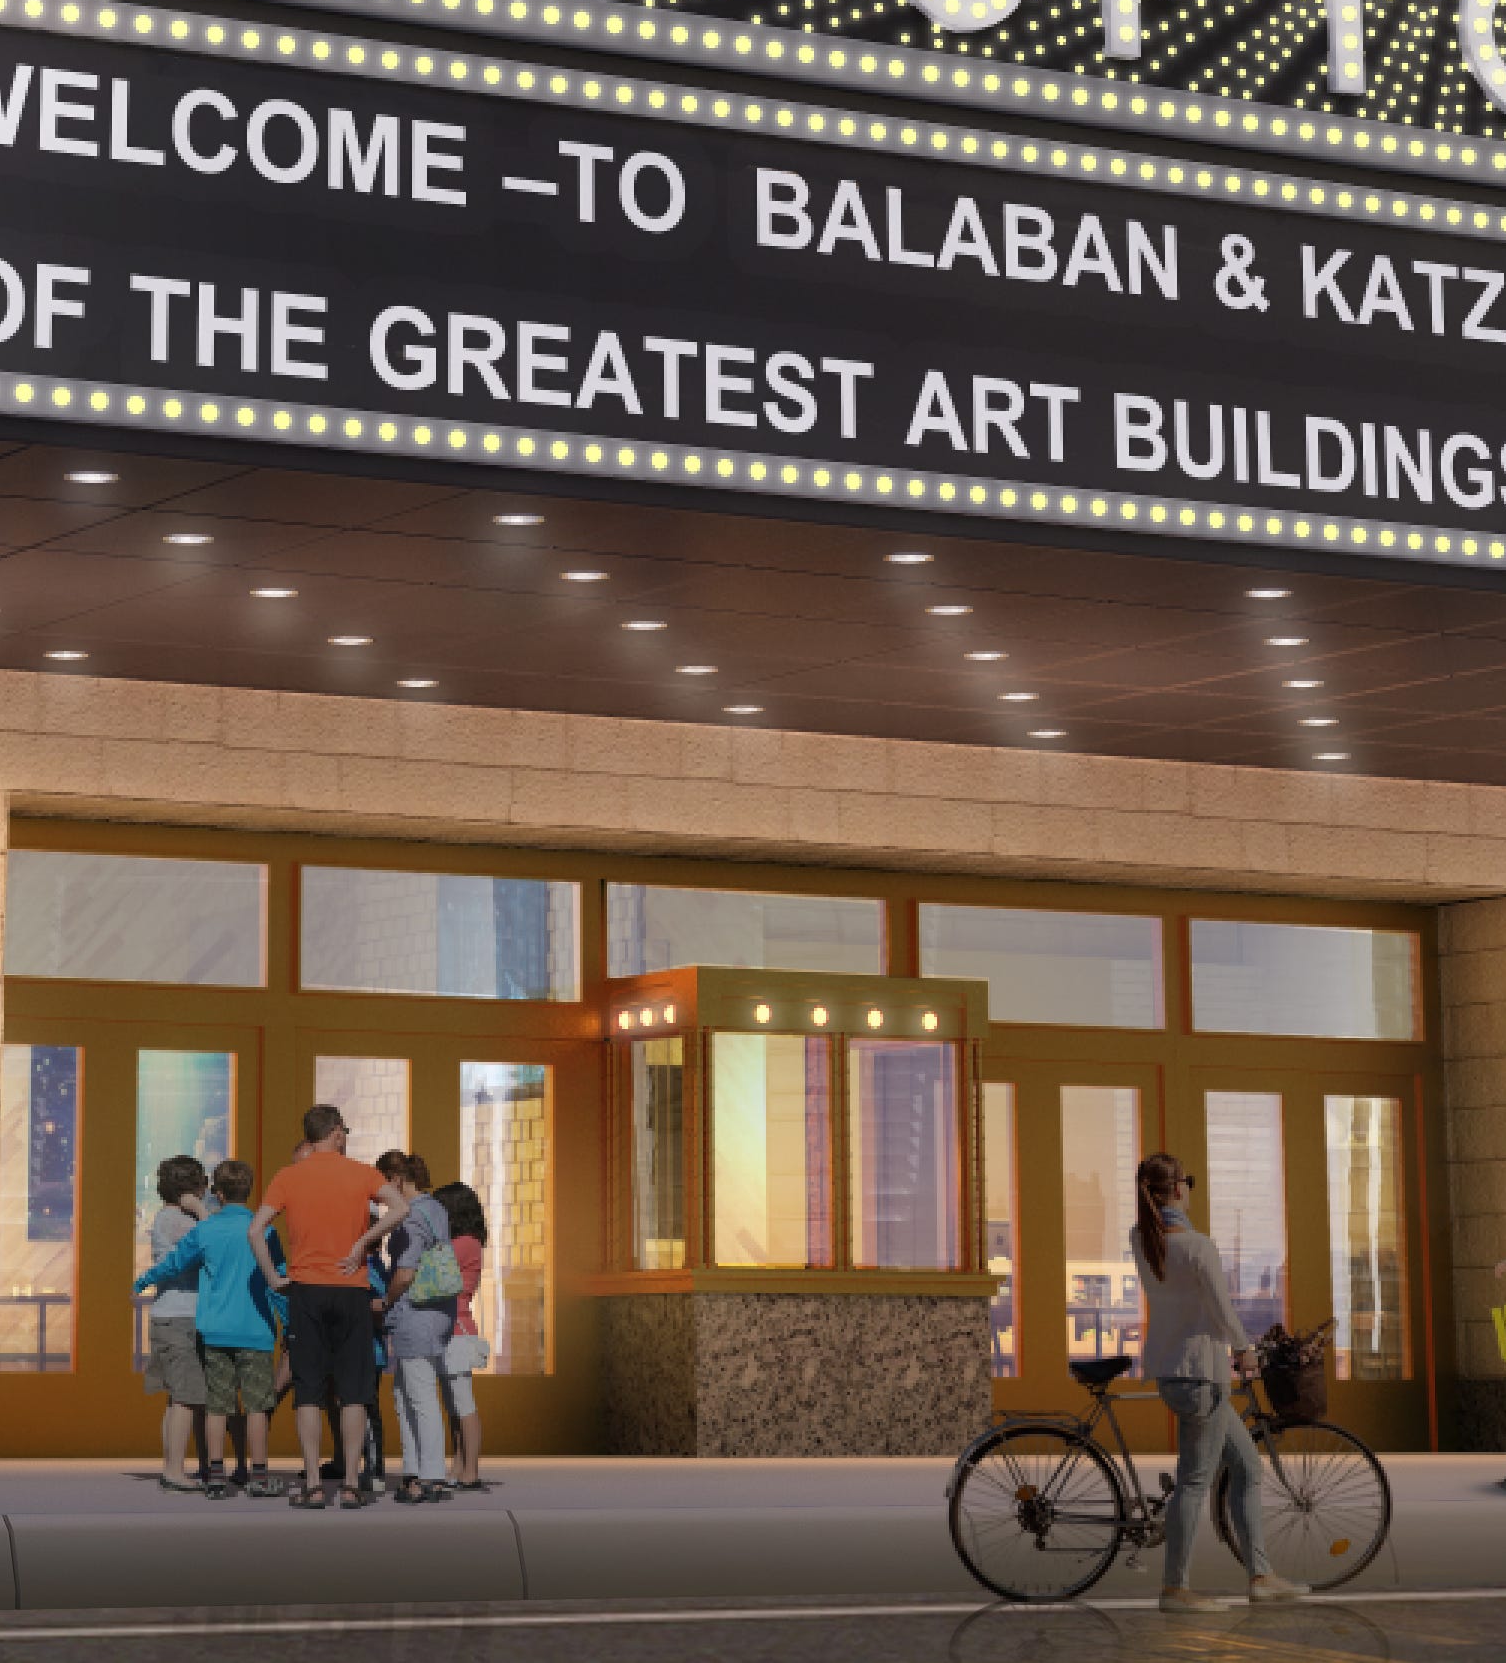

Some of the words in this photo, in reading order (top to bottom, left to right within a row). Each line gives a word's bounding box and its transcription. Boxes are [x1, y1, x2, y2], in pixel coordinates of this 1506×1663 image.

[756, 167, 1178, 301] BALABAN
[1214, 232, 1270, 313] &
[130, 274, 329, 379] THE
[369, 305, 875, 439] GREATEST
[906, 371, 1080, 463] ART
